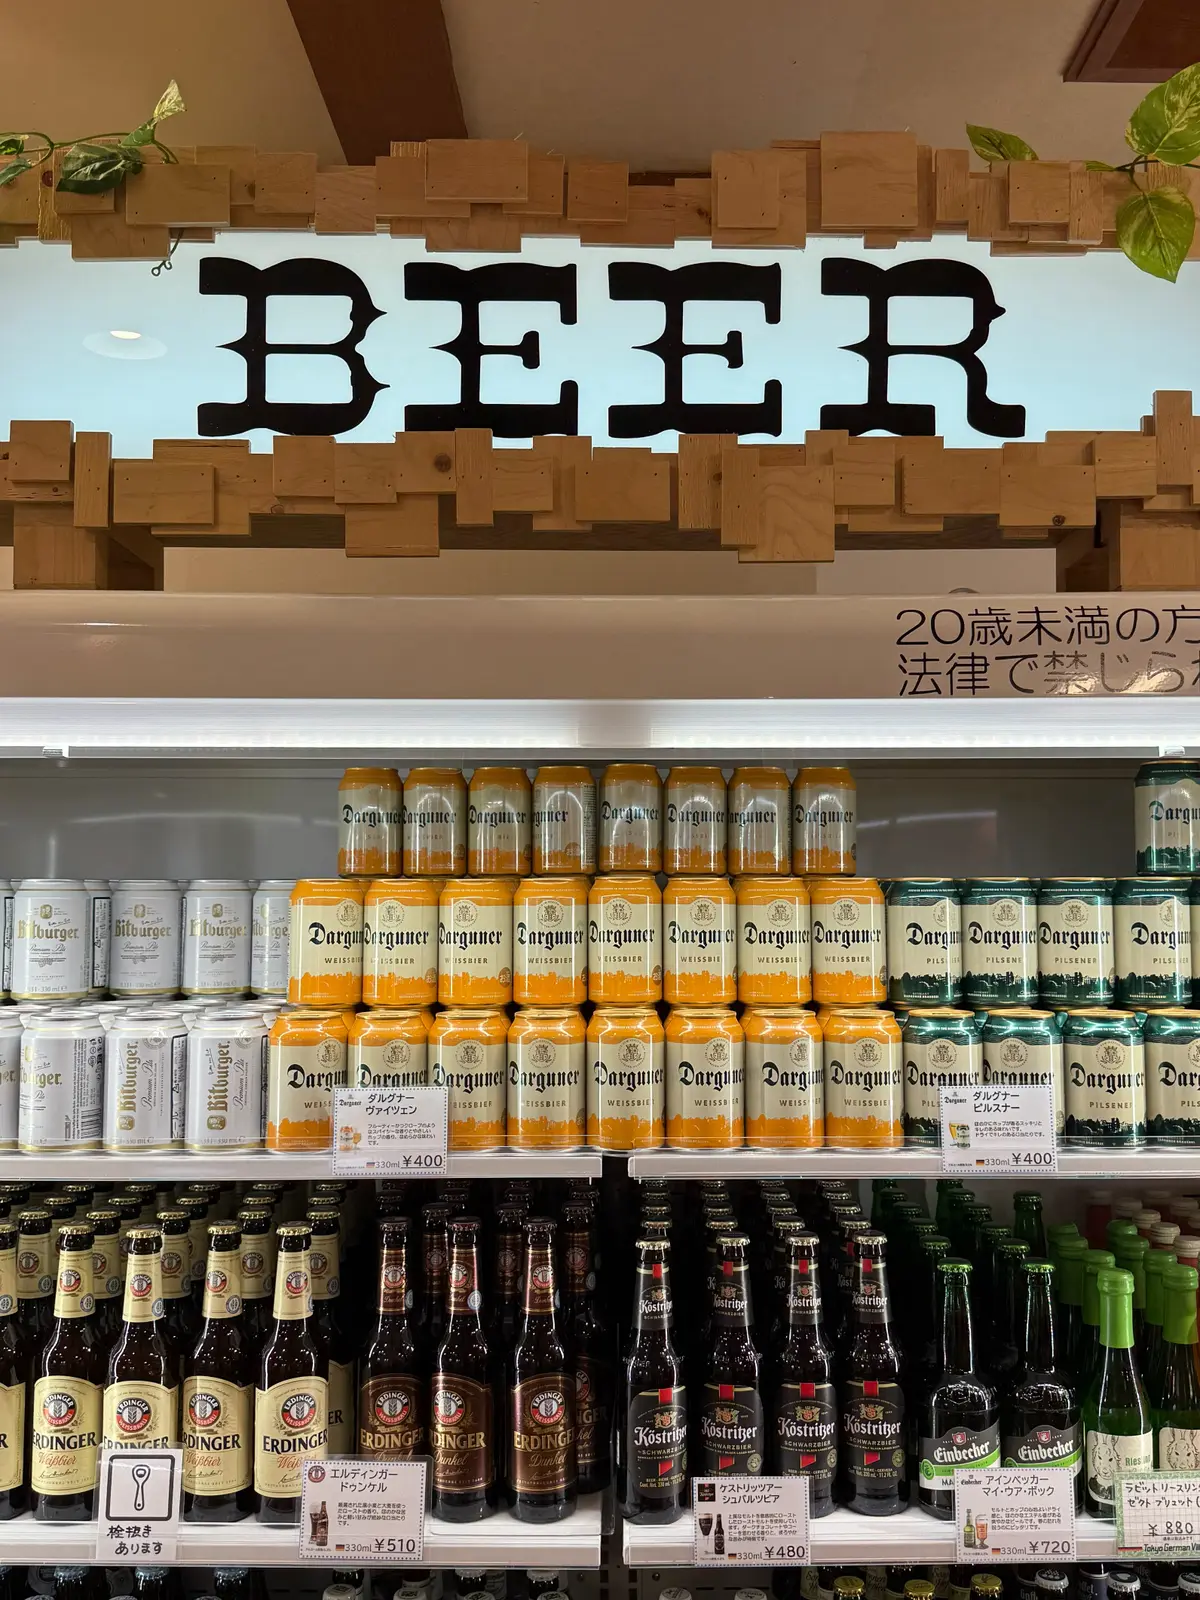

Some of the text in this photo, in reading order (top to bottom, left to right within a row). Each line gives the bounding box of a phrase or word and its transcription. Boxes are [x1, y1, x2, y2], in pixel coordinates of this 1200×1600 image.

[196, 257, 1026, 438] BEER
[896, 605, 1200, 646] 20歳未満の方
[469, 803, 526, 828] Darguner
[601, 800, 659, 824] Darguner
[795, 803, 854, 827] Darguner
[517, 921, 584, 951] Darguner
[589, 920, 655, 949] Darguner
[668, 920, 734, 949] Darguner
[744, 921, 810, 950] Darguner
[813, 920, 882, 949] Darguner
[1039, 921, 1110, 951] Darguner
[825, 955, 871, 963] WEISSBIER
[432, 1062, 504, 1093] Darguner
[509, 1060, 580, 1093] Darguner
[594, 1060, 664, 1092] Darguner
[679, 1061, 745, 1092] Darguner
[830, 1060, 902, 1092] Darguner
[906, 1060, 980, 1087] Darguner
[1070, 1061, 1144, 1094] Darguner
[367, 1093, 415, 1104] ダルグナー
[973, 1091, 1020, 1101] ダルグナー
[365, 1106, 417, 1115] ヴァイツェン
[973, 1103, 1020, 1113] ピルスナー
[375, 1154, 443, 1169] 330ml ¥400
[985, 1152, 1052, 1166] 330ml ¥400
[43, 1393, 75, 1408] ERDINGER
[117, 1397, 151, 1414] ERDINGER
[189, 1393, 220, 1410] ERDINGER
[282, 1393, 315, 1410] ERDINGER
[377, 1391, 408, 1406] ERDINGER
[532, 1391, 563, 1407] ERDINGER
[633, 1424, 687, 1447] Köstritzer
[701, 1416, 758, 1443] Köstritzer
[777, 1416, 835, 1440] Köstritzer
[843, 1413, 901, 1439] Köstritzer
[263, 1428, 328, 1454] ERDINGER
[330, 1468, 398, 1480] エルディンガー
[985, 1475, 1049, 1485] アインベッカー
[340, 1482, 388, 1493] ドゥンケル
[107, 1524, 152, 1539] 栓抜き
[115, 1541, 163, 1556] あります
[345, 1538, 416, 1552] 330ml ¥510
[737, 1545, 805, 1560] 330ml ¥480
[1000, 1541, 1071, 1555] 330ml ¥720
[1143, 1543, 1191, 1554] Tokyo German
